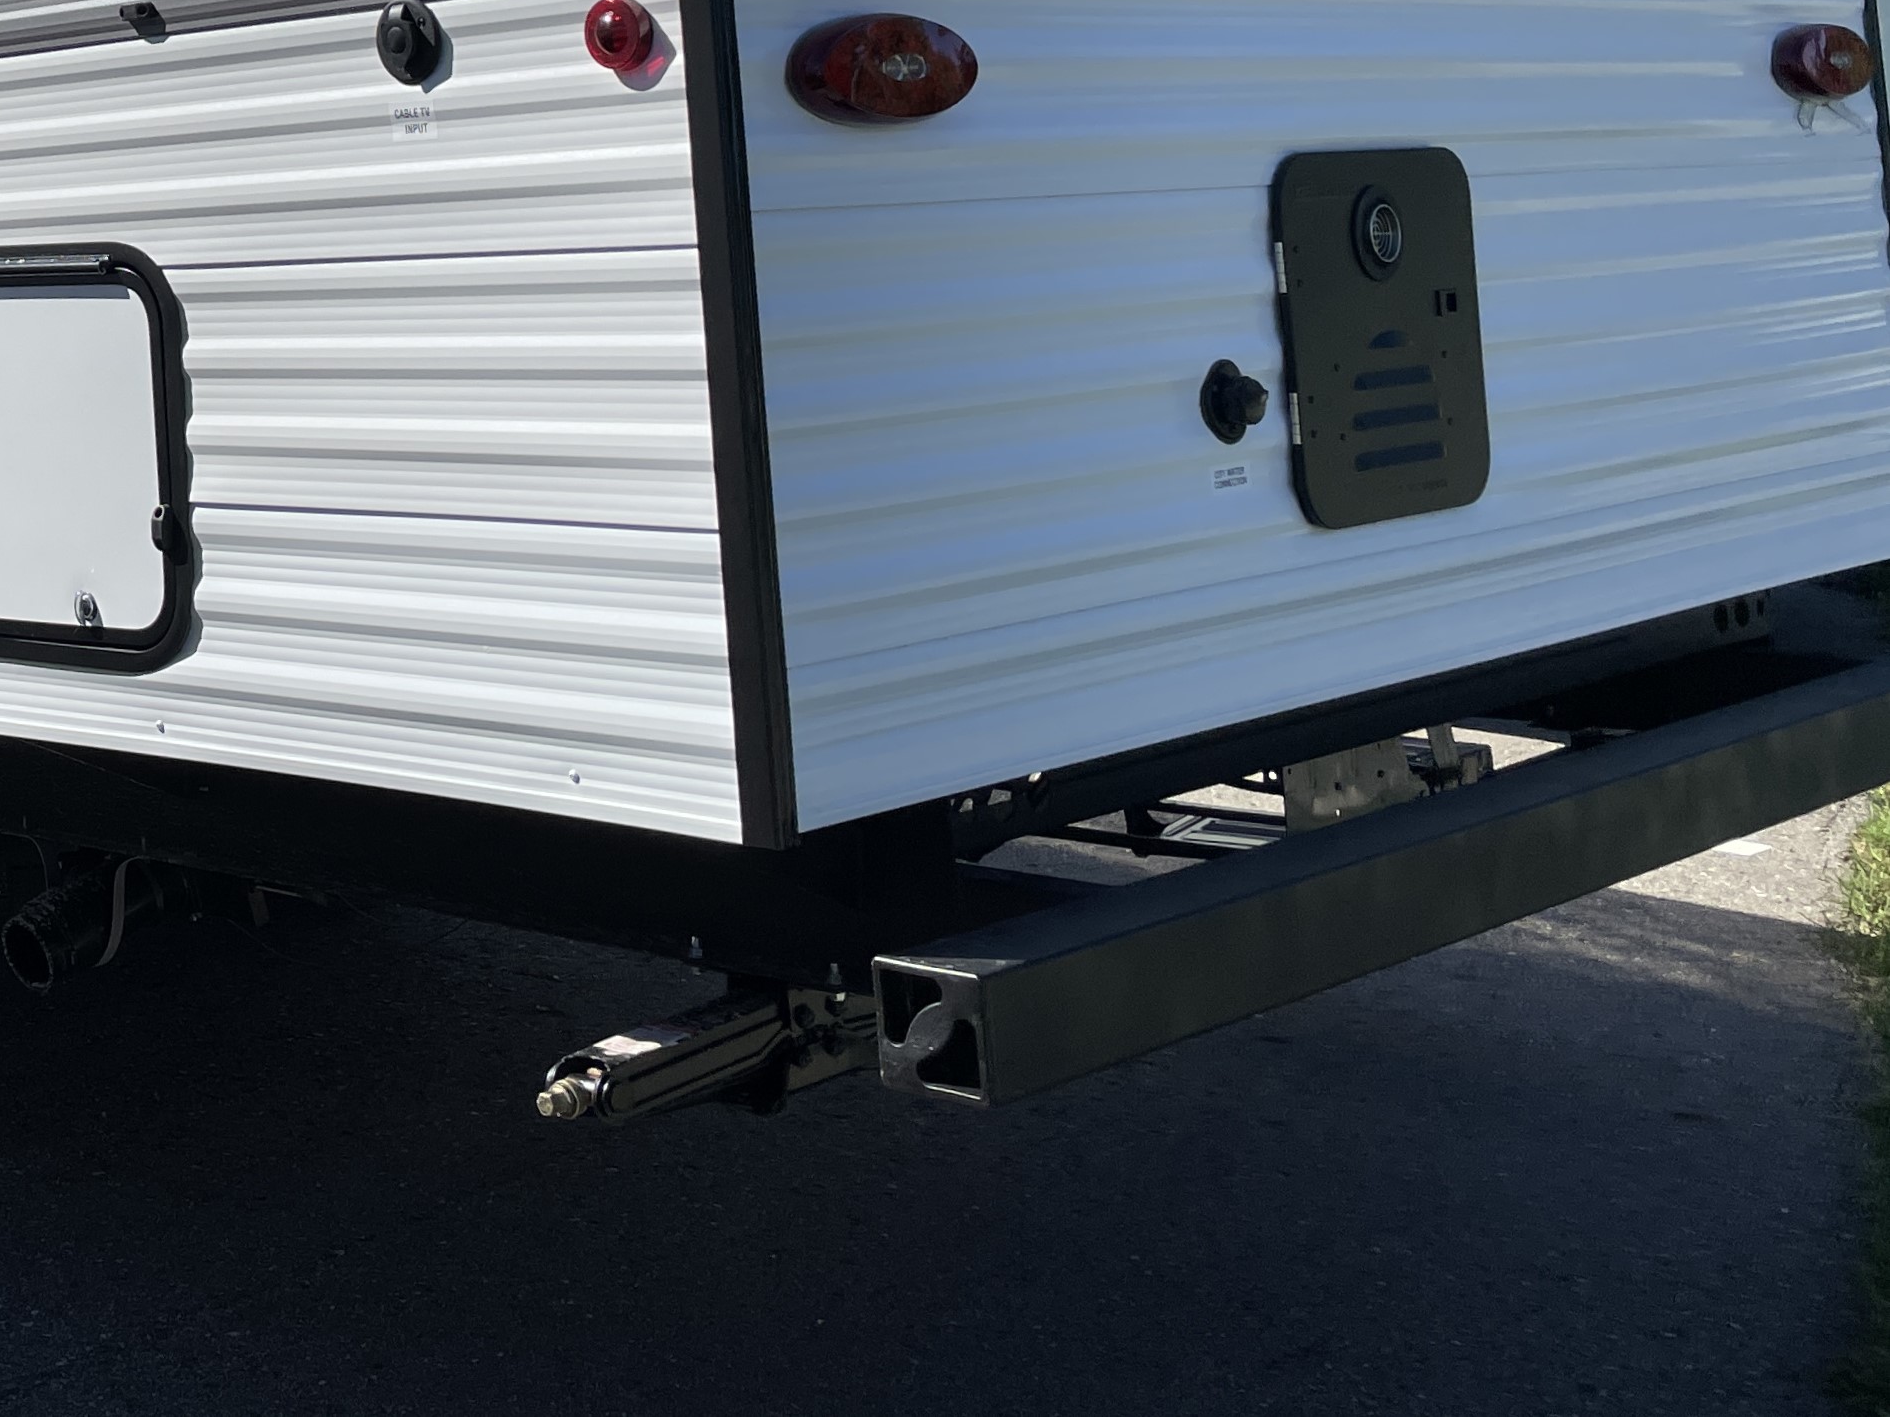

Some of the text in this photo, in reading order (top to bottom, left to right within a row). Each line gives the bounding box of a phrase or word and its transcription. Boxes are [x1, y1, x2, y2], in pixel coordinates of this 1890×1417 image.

[394, 106, 430, 119] CABLE TV
[405, 122, 428, 134] INPUT
